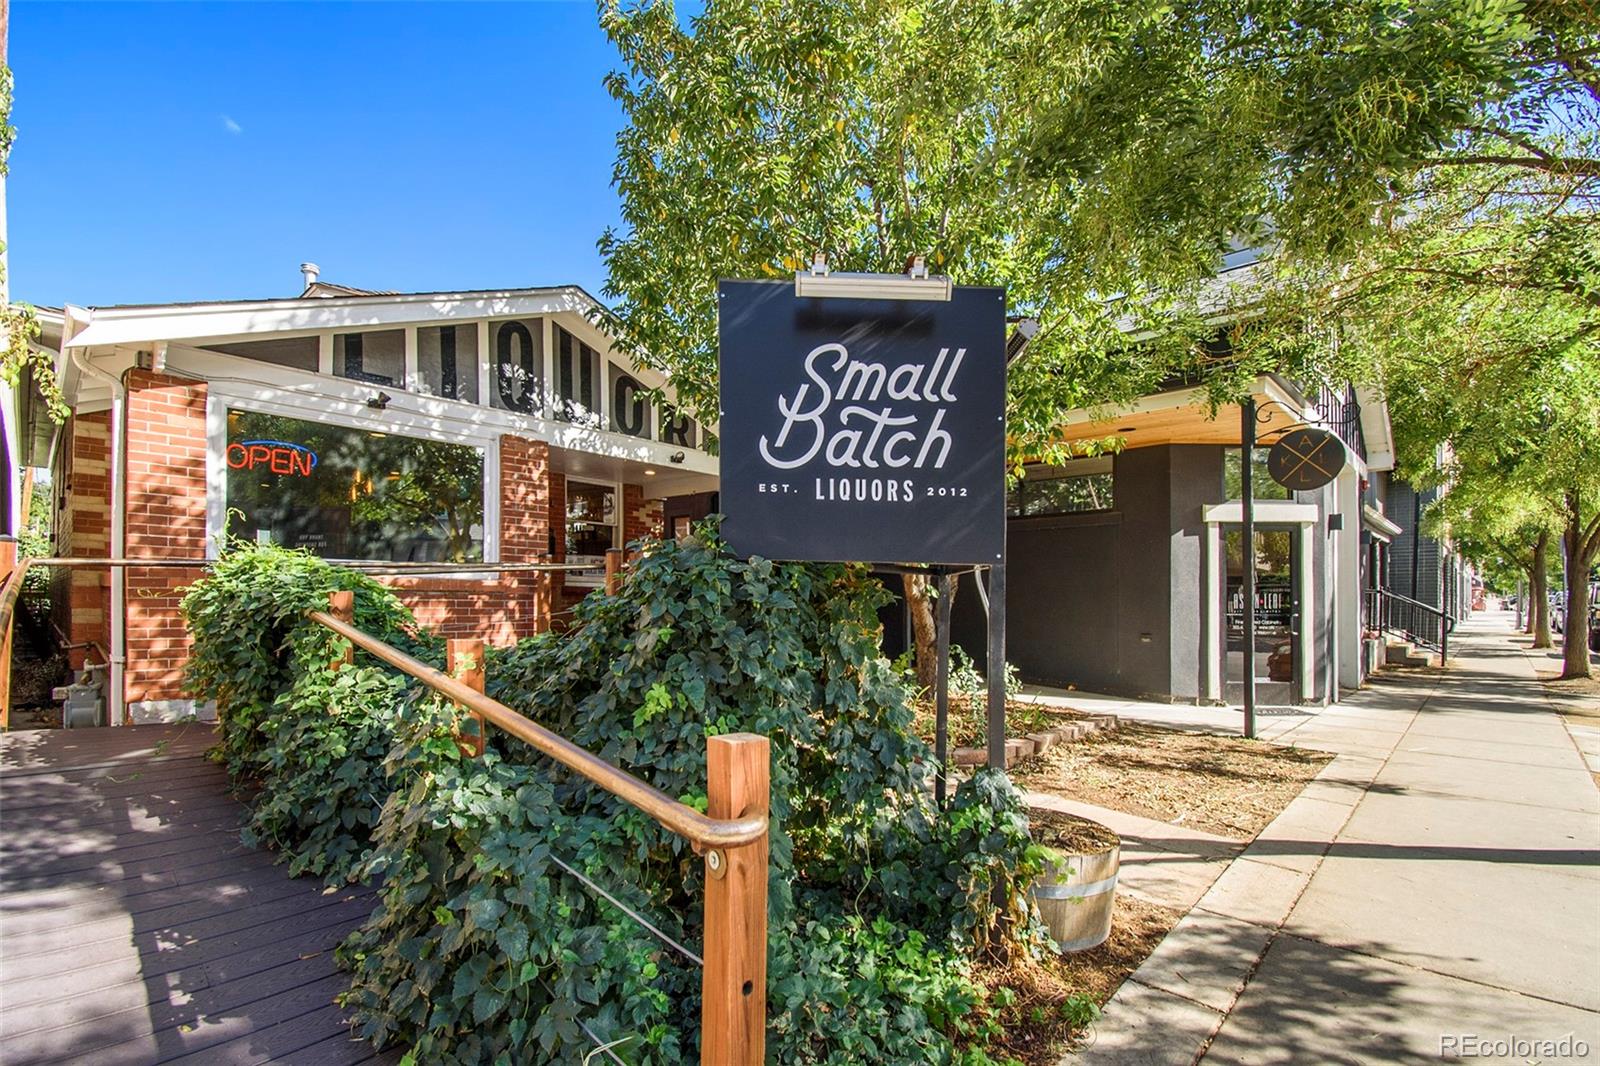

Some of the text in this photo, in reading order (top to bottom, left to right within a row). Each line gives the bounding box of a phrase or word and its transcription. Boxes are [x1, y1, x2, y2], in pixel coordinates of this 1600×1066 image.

[779, 343, 967, 418] Small
[759, 384, 953, 470] Batch
[226, 443, 312, 477] OPEN
[758, 478, 968, 502] EST. LIQUORS 2012
